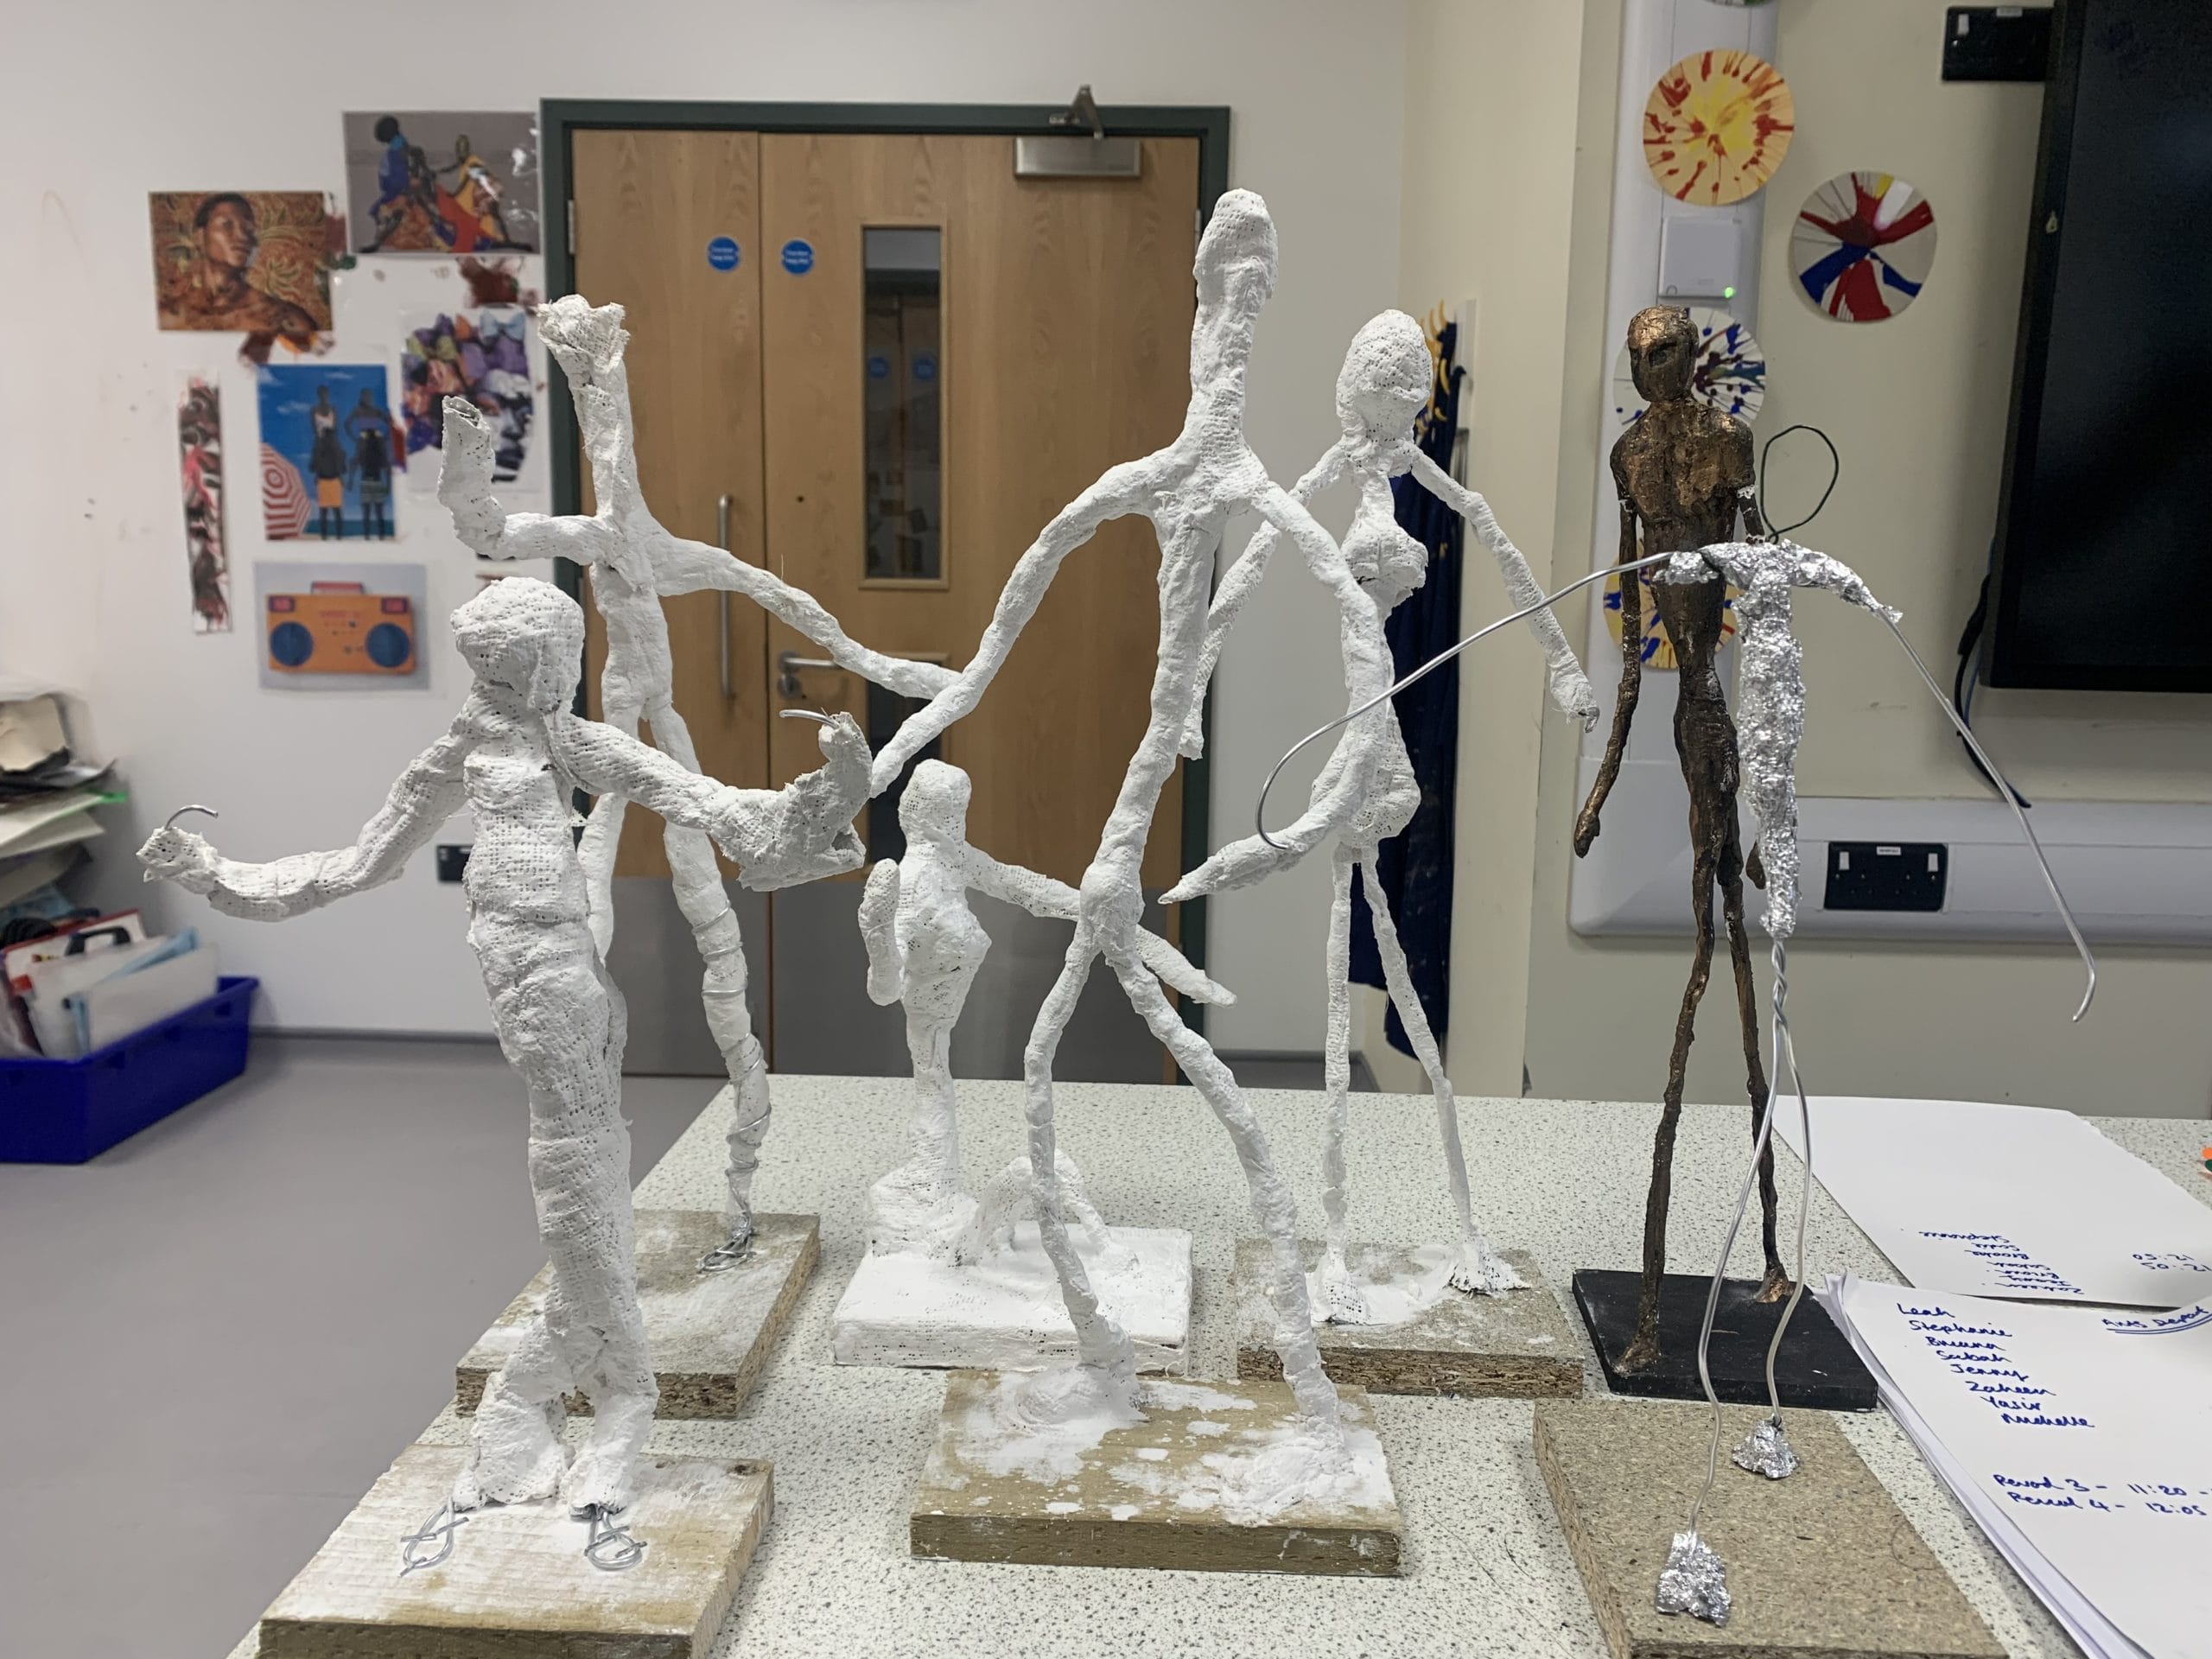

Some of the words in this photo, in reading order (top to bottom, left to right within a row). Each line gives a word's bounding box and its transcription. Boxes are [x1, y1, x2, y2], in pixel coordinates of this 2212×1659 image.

[1897, 1303, 1955, 1318] Leah
[1909, 1320, 2012, 1337] Stephanie
[1950, 1363, 2029, 1382] Jenny
[2065, 1478, 2090, 1491] 3
[2127, 1484, 2187, 1496] 11:20
[2089, 1499, 2111, 1512] 4
[2145, 1502, 2207, 1516] 12:05
